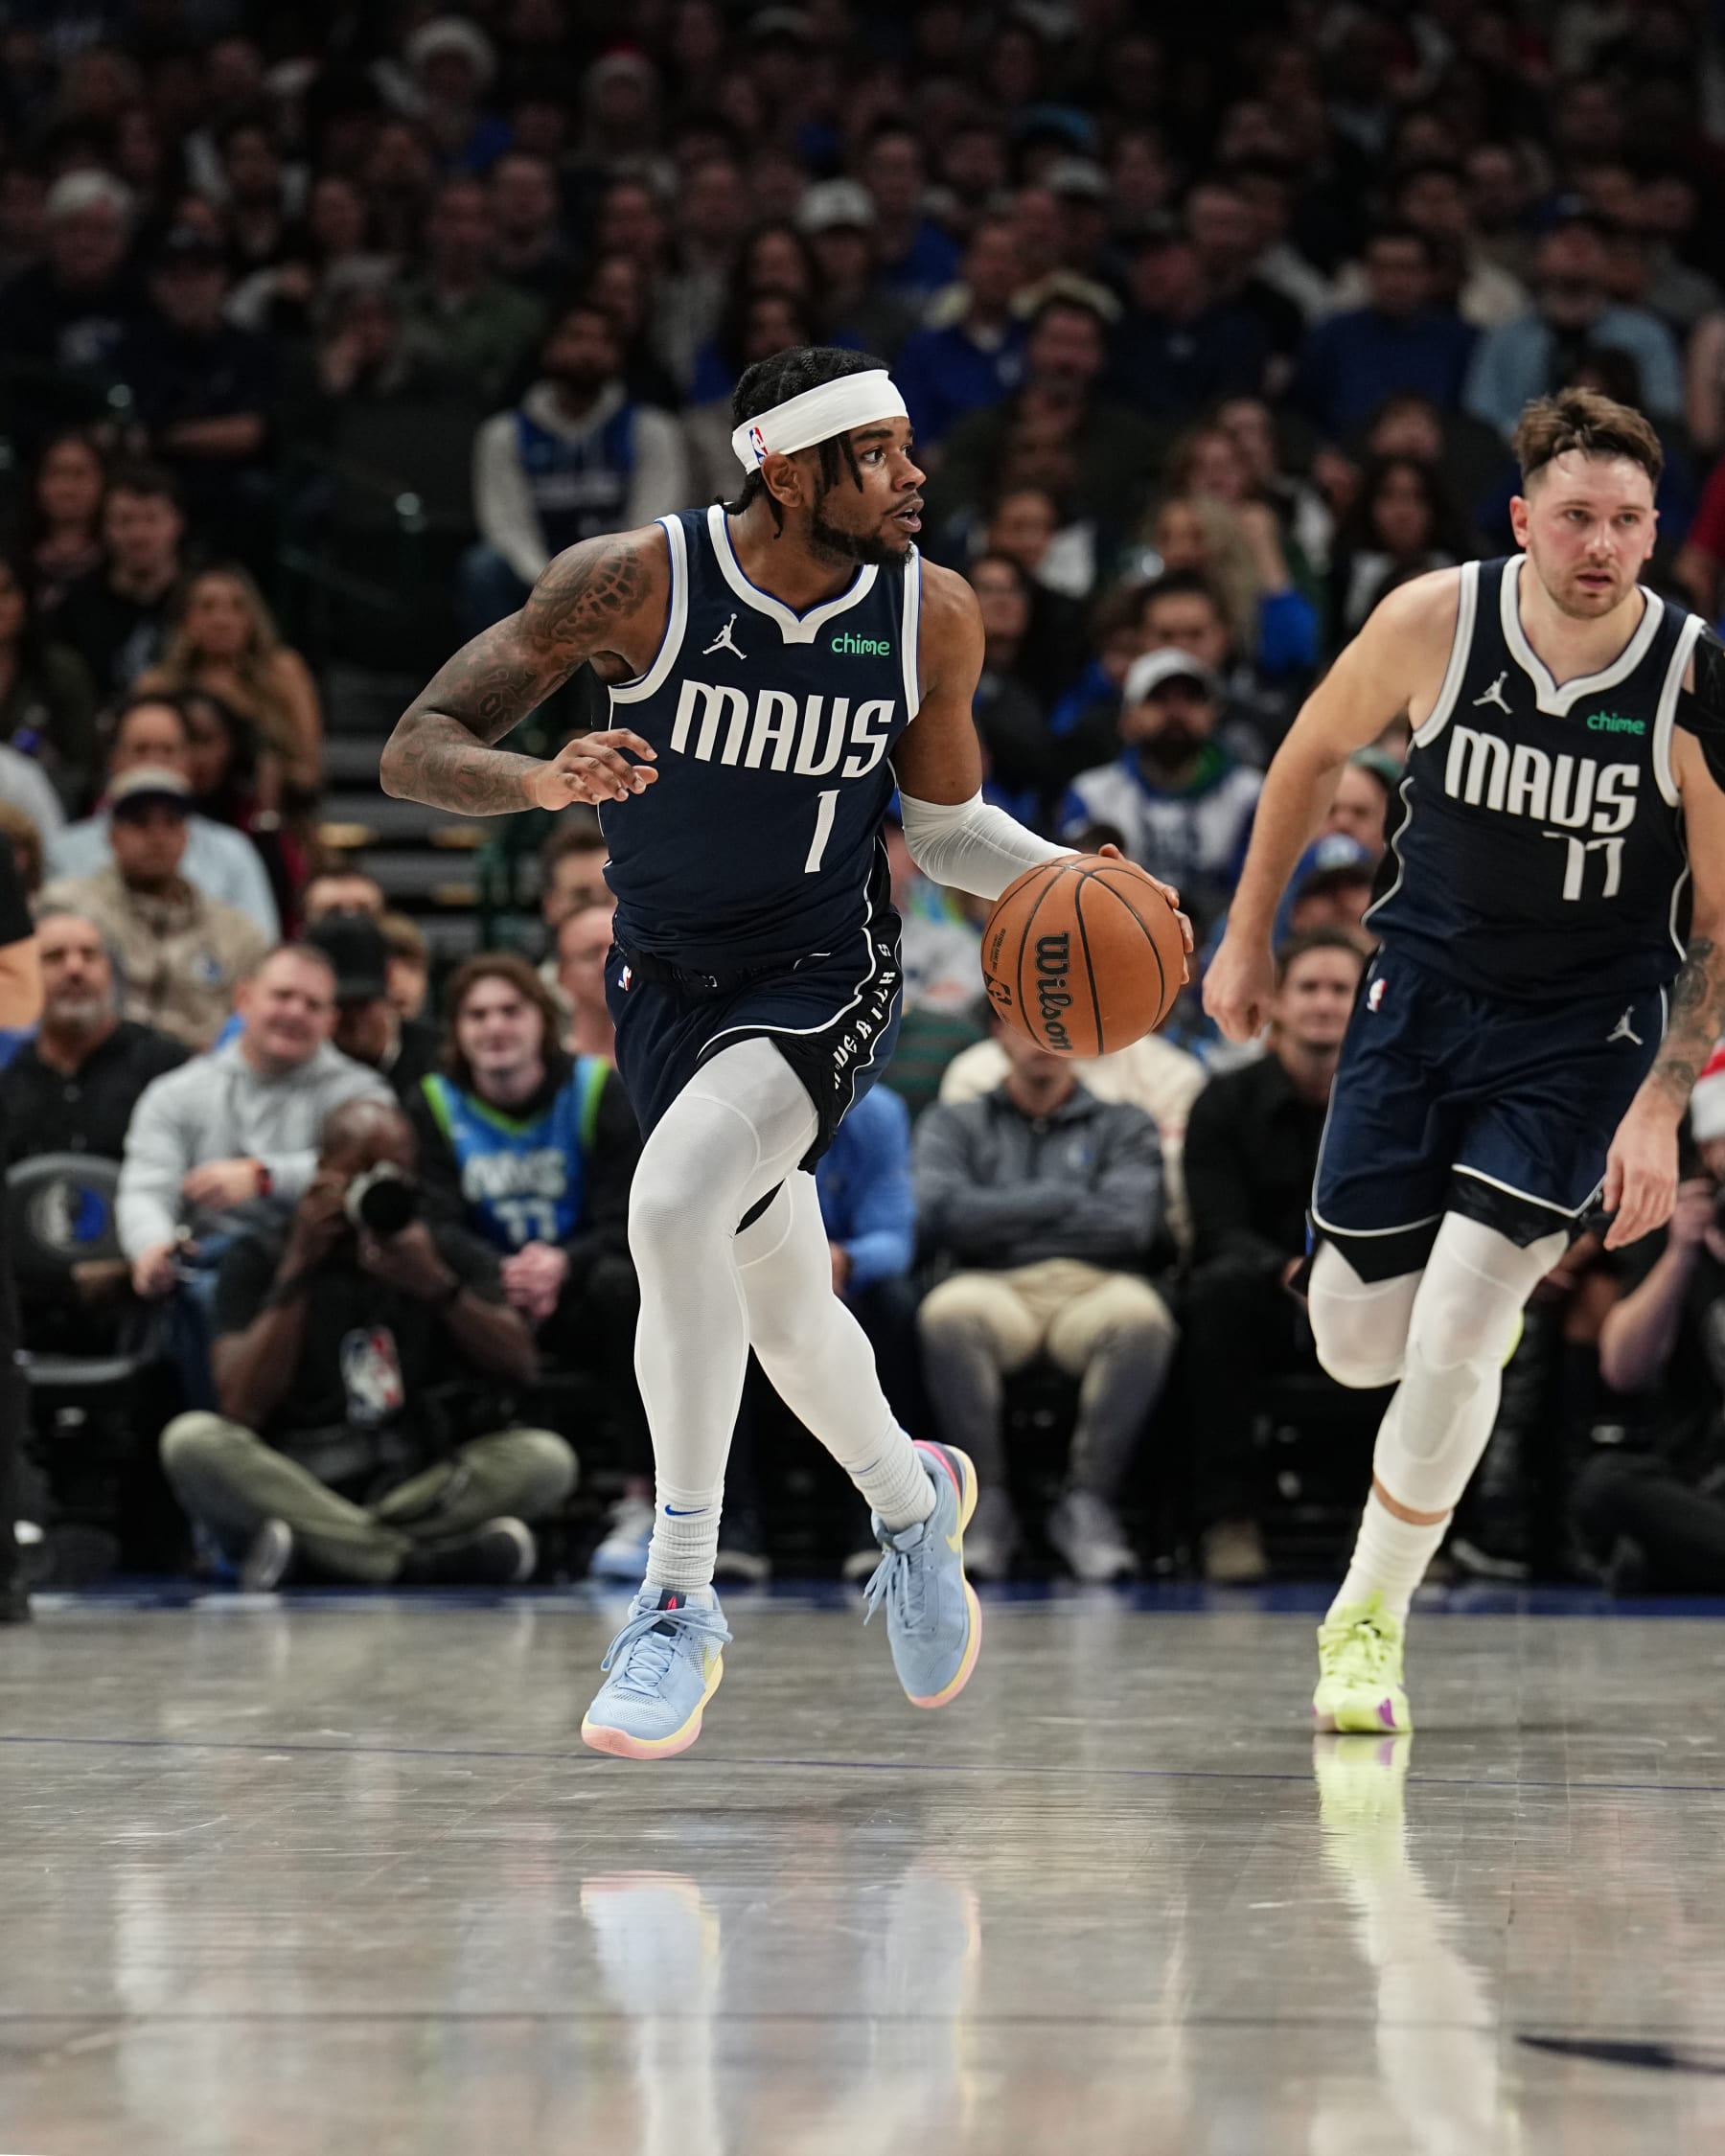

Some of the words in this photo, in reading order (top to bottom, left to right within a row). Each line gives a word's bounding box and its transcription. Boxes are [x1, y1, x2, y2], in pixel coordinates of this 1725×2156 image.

[832, 632, 890, 656] chime
[1587, 710, 1645, 736] chime
[804, 789, 840, 874] 1
[1542, 830, 1626, 902] 77
[1034, 932, 1073, 1051] Wilson
